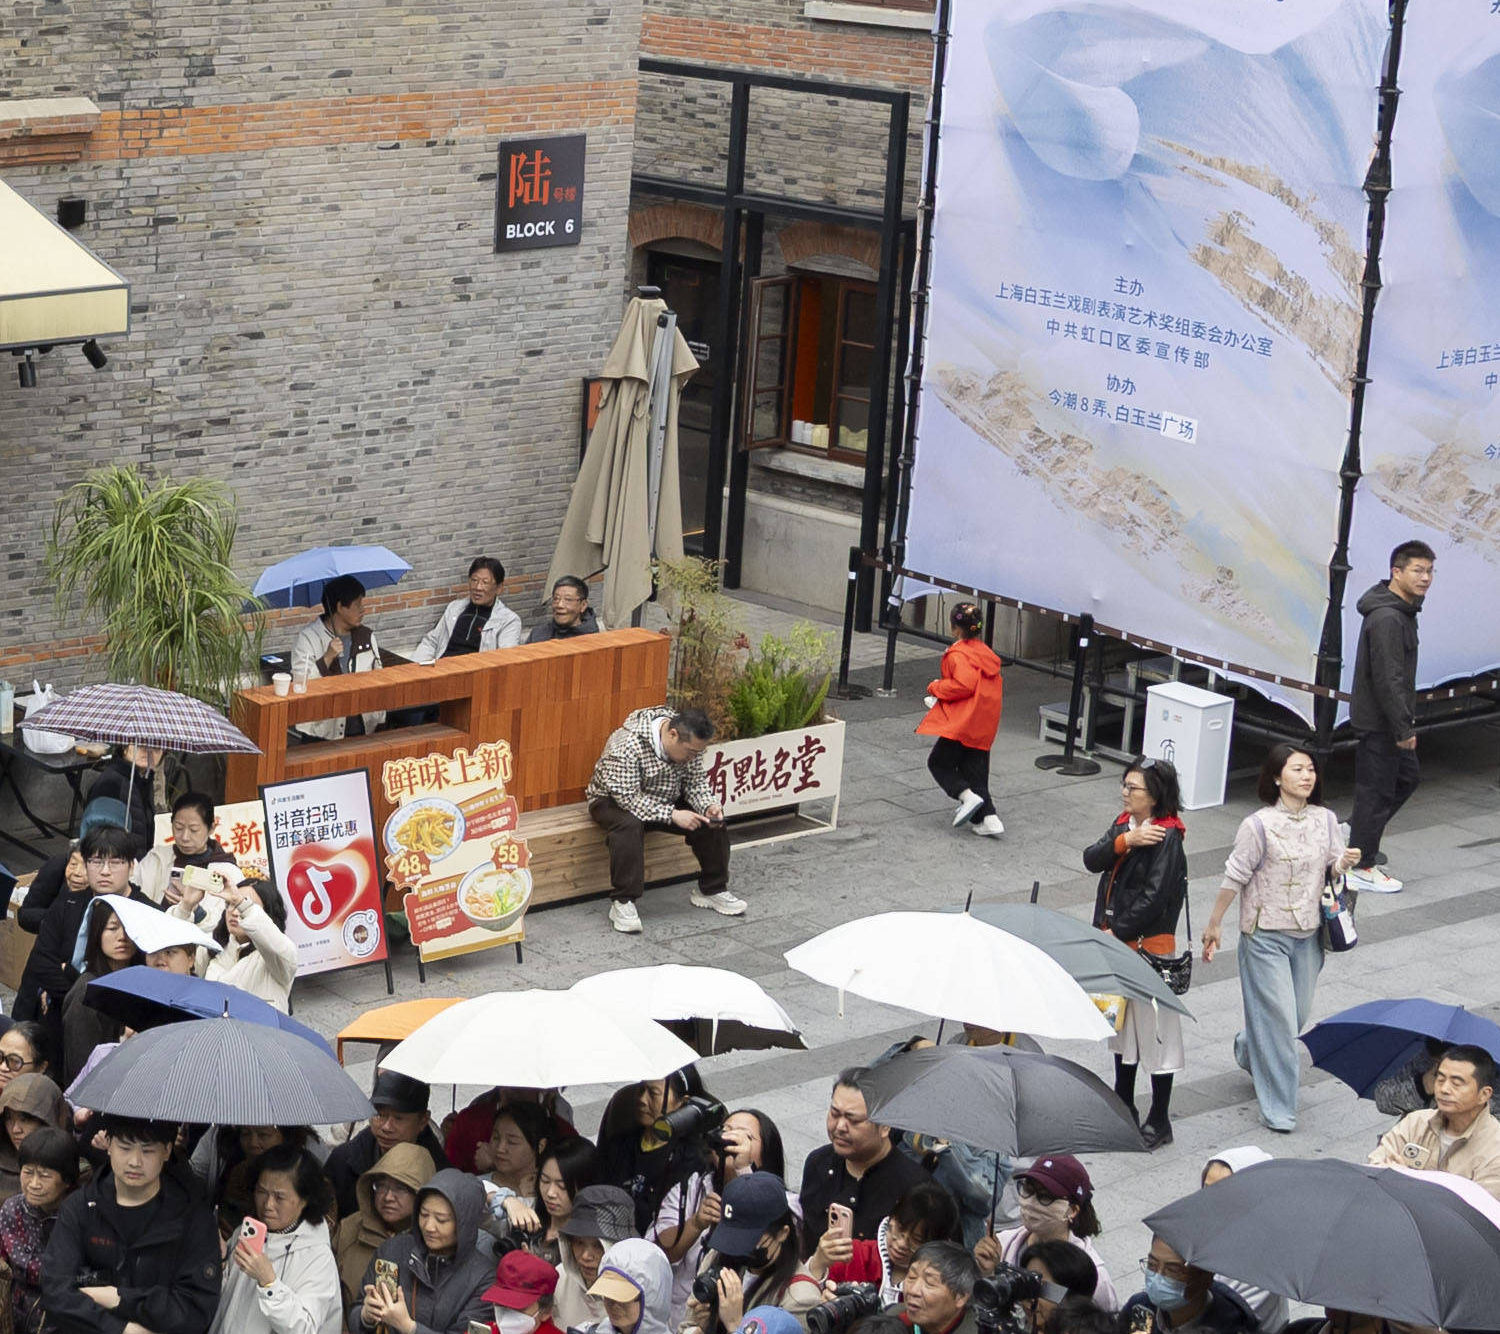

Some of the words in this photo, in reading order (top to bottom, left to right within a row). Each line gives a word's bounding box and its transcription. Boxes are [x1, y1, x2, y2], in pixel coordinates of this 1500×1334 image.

[506, 220, 556, 239] BLOCK
[565, 219, 575, 234] 6
[1114, 275, 1145, 297] 主办
[995, 282, 1274, 357] 上海白玉兰戏剧表演艺术奖组委会办公室
[1046, 318, 1210, 369] 中共虹口区委宣传部
[1106, 373, 1137, 396] 协办
[386, 743, 510, 797] 鲜味上新
[274, 803, 337, 832] 抖音扫码
[275, 820, 358, 849] 团套餐更优惠
[498, 845, 519, 864] 58
